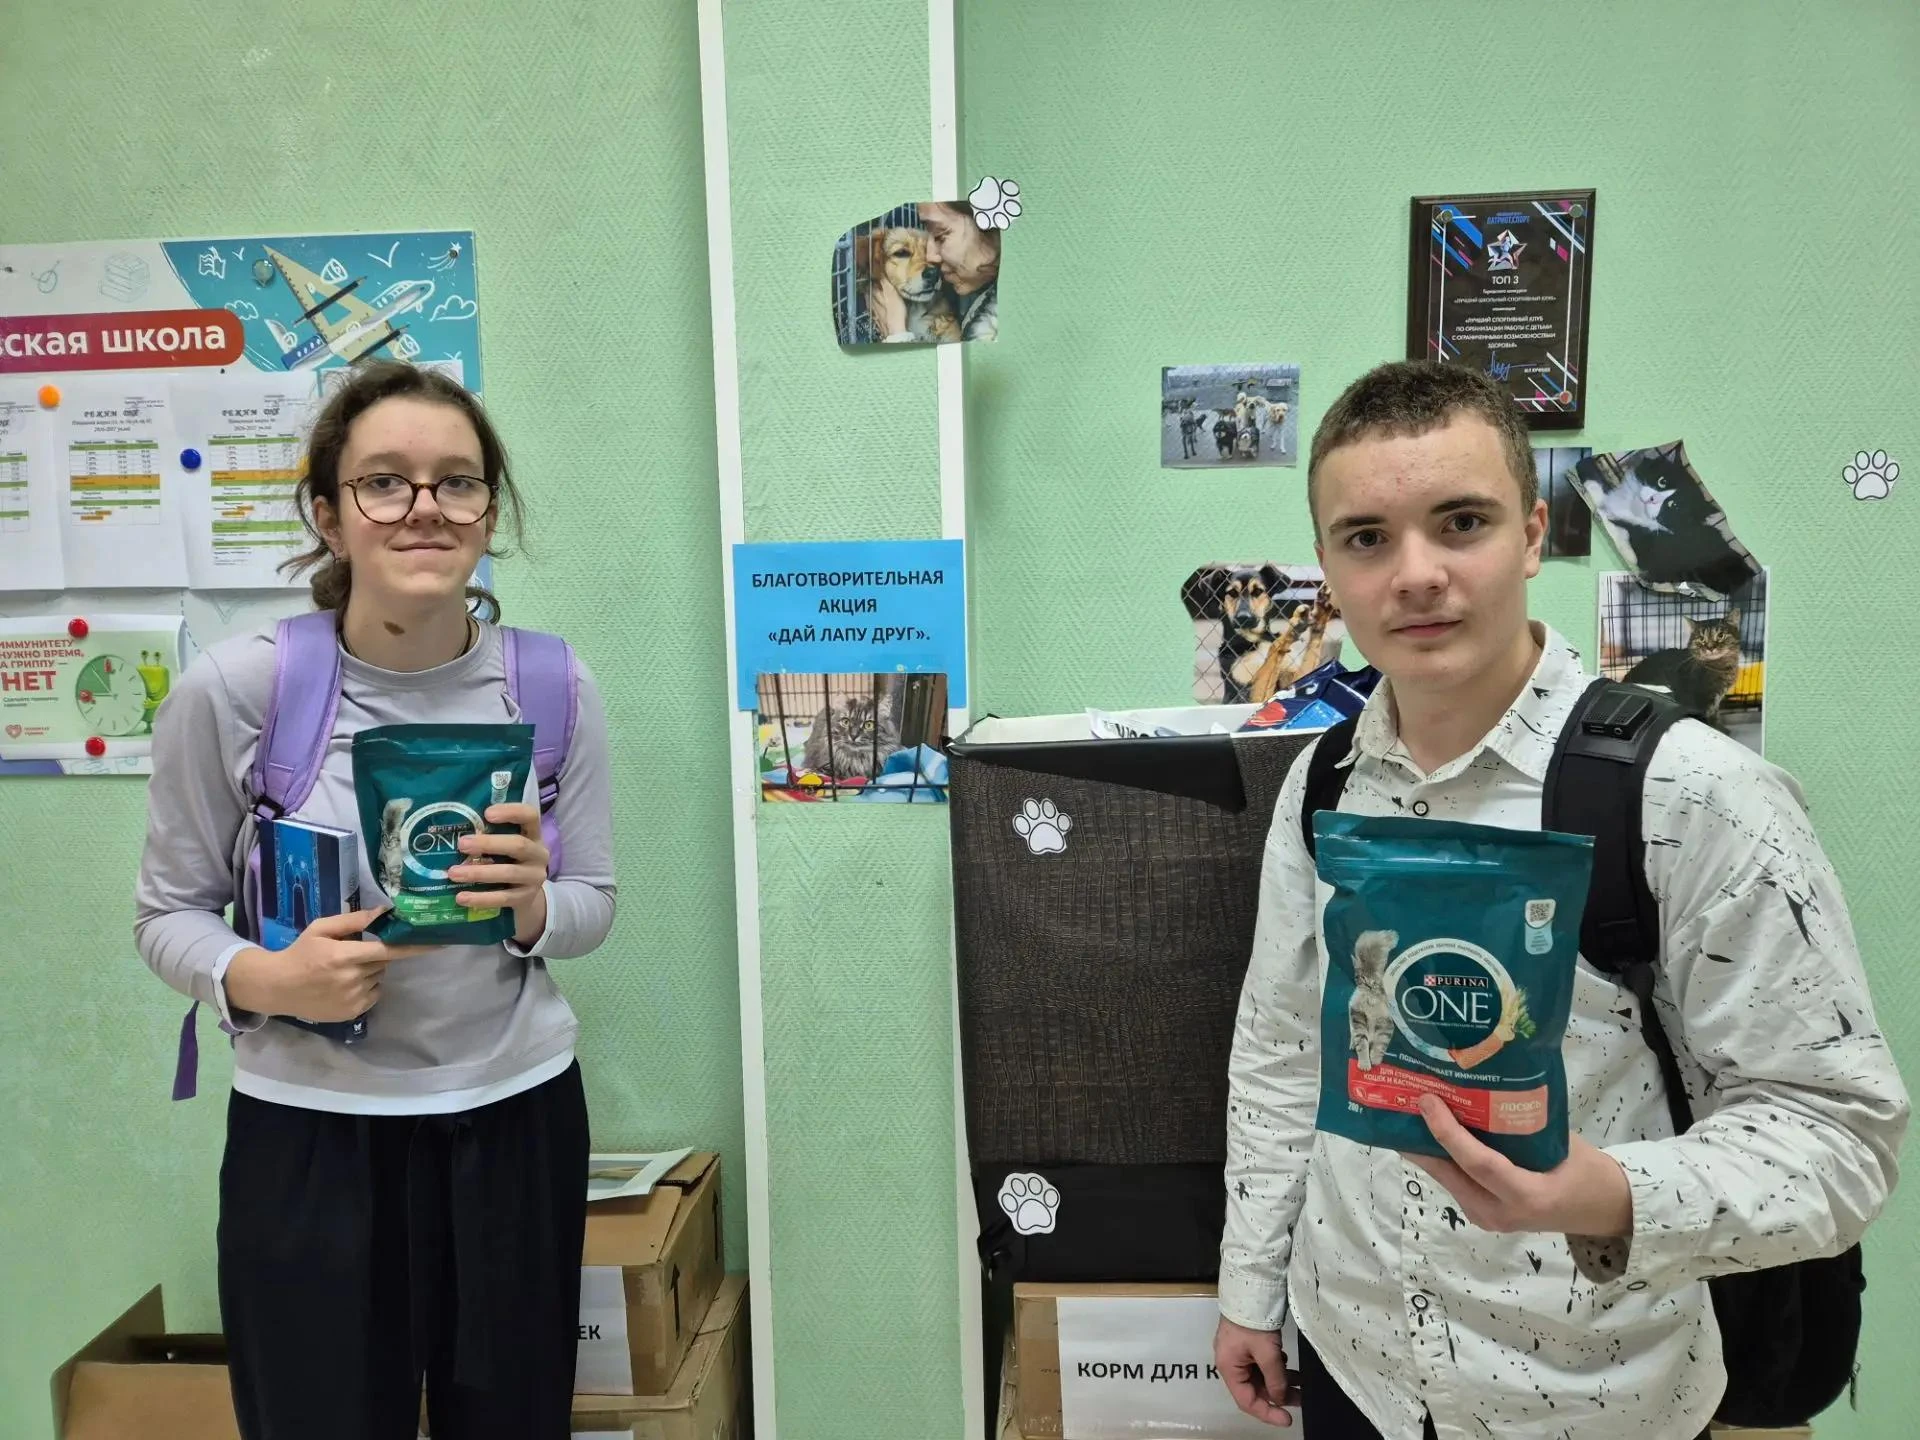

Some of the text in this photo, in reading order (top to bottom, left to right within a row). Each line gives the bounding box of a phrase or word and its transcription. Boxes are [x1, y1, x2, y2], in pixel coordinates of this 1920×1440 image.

[1491, 275, 1519, 285] ТОП 3
[0, 325, 225, 358] ская школа
[752, 570, 944, 588] БЛАГОТВОРИТЕЛЬНАЯ
[818, 598, 877, 616] АКЦИЯ
[768, 625, 931, 645] «ДАЙ ЛАПУ ДРУГ».
[0, 639, 73, 649] ИММУНИТЕТУ
[0, 649, 85, 659] НУЖНО ВРЕМЯ,
[11, 660, 55, 668] ГРИППУ
[1, 671, 56, 691] НЕТ
[1437, 976, 1486, 987] PURINA
[1402, 985, 1492, 1024] ONE
[1380, 1067, 1394, 1076] ДЛЯ
[1454, 1072, 1501, 1082] ИММУНИТЕТ
[1364, 1074, 1388, 1084] КОШЕК
[1451, 1095, 1472, 1106] КОТОВ
[1347, 1101, 1359, 1113] 200
[577, 1325, 601, 1340] ЕК
[1077, 1362, 1220, 1382] КОРМ ДЛЯ К
